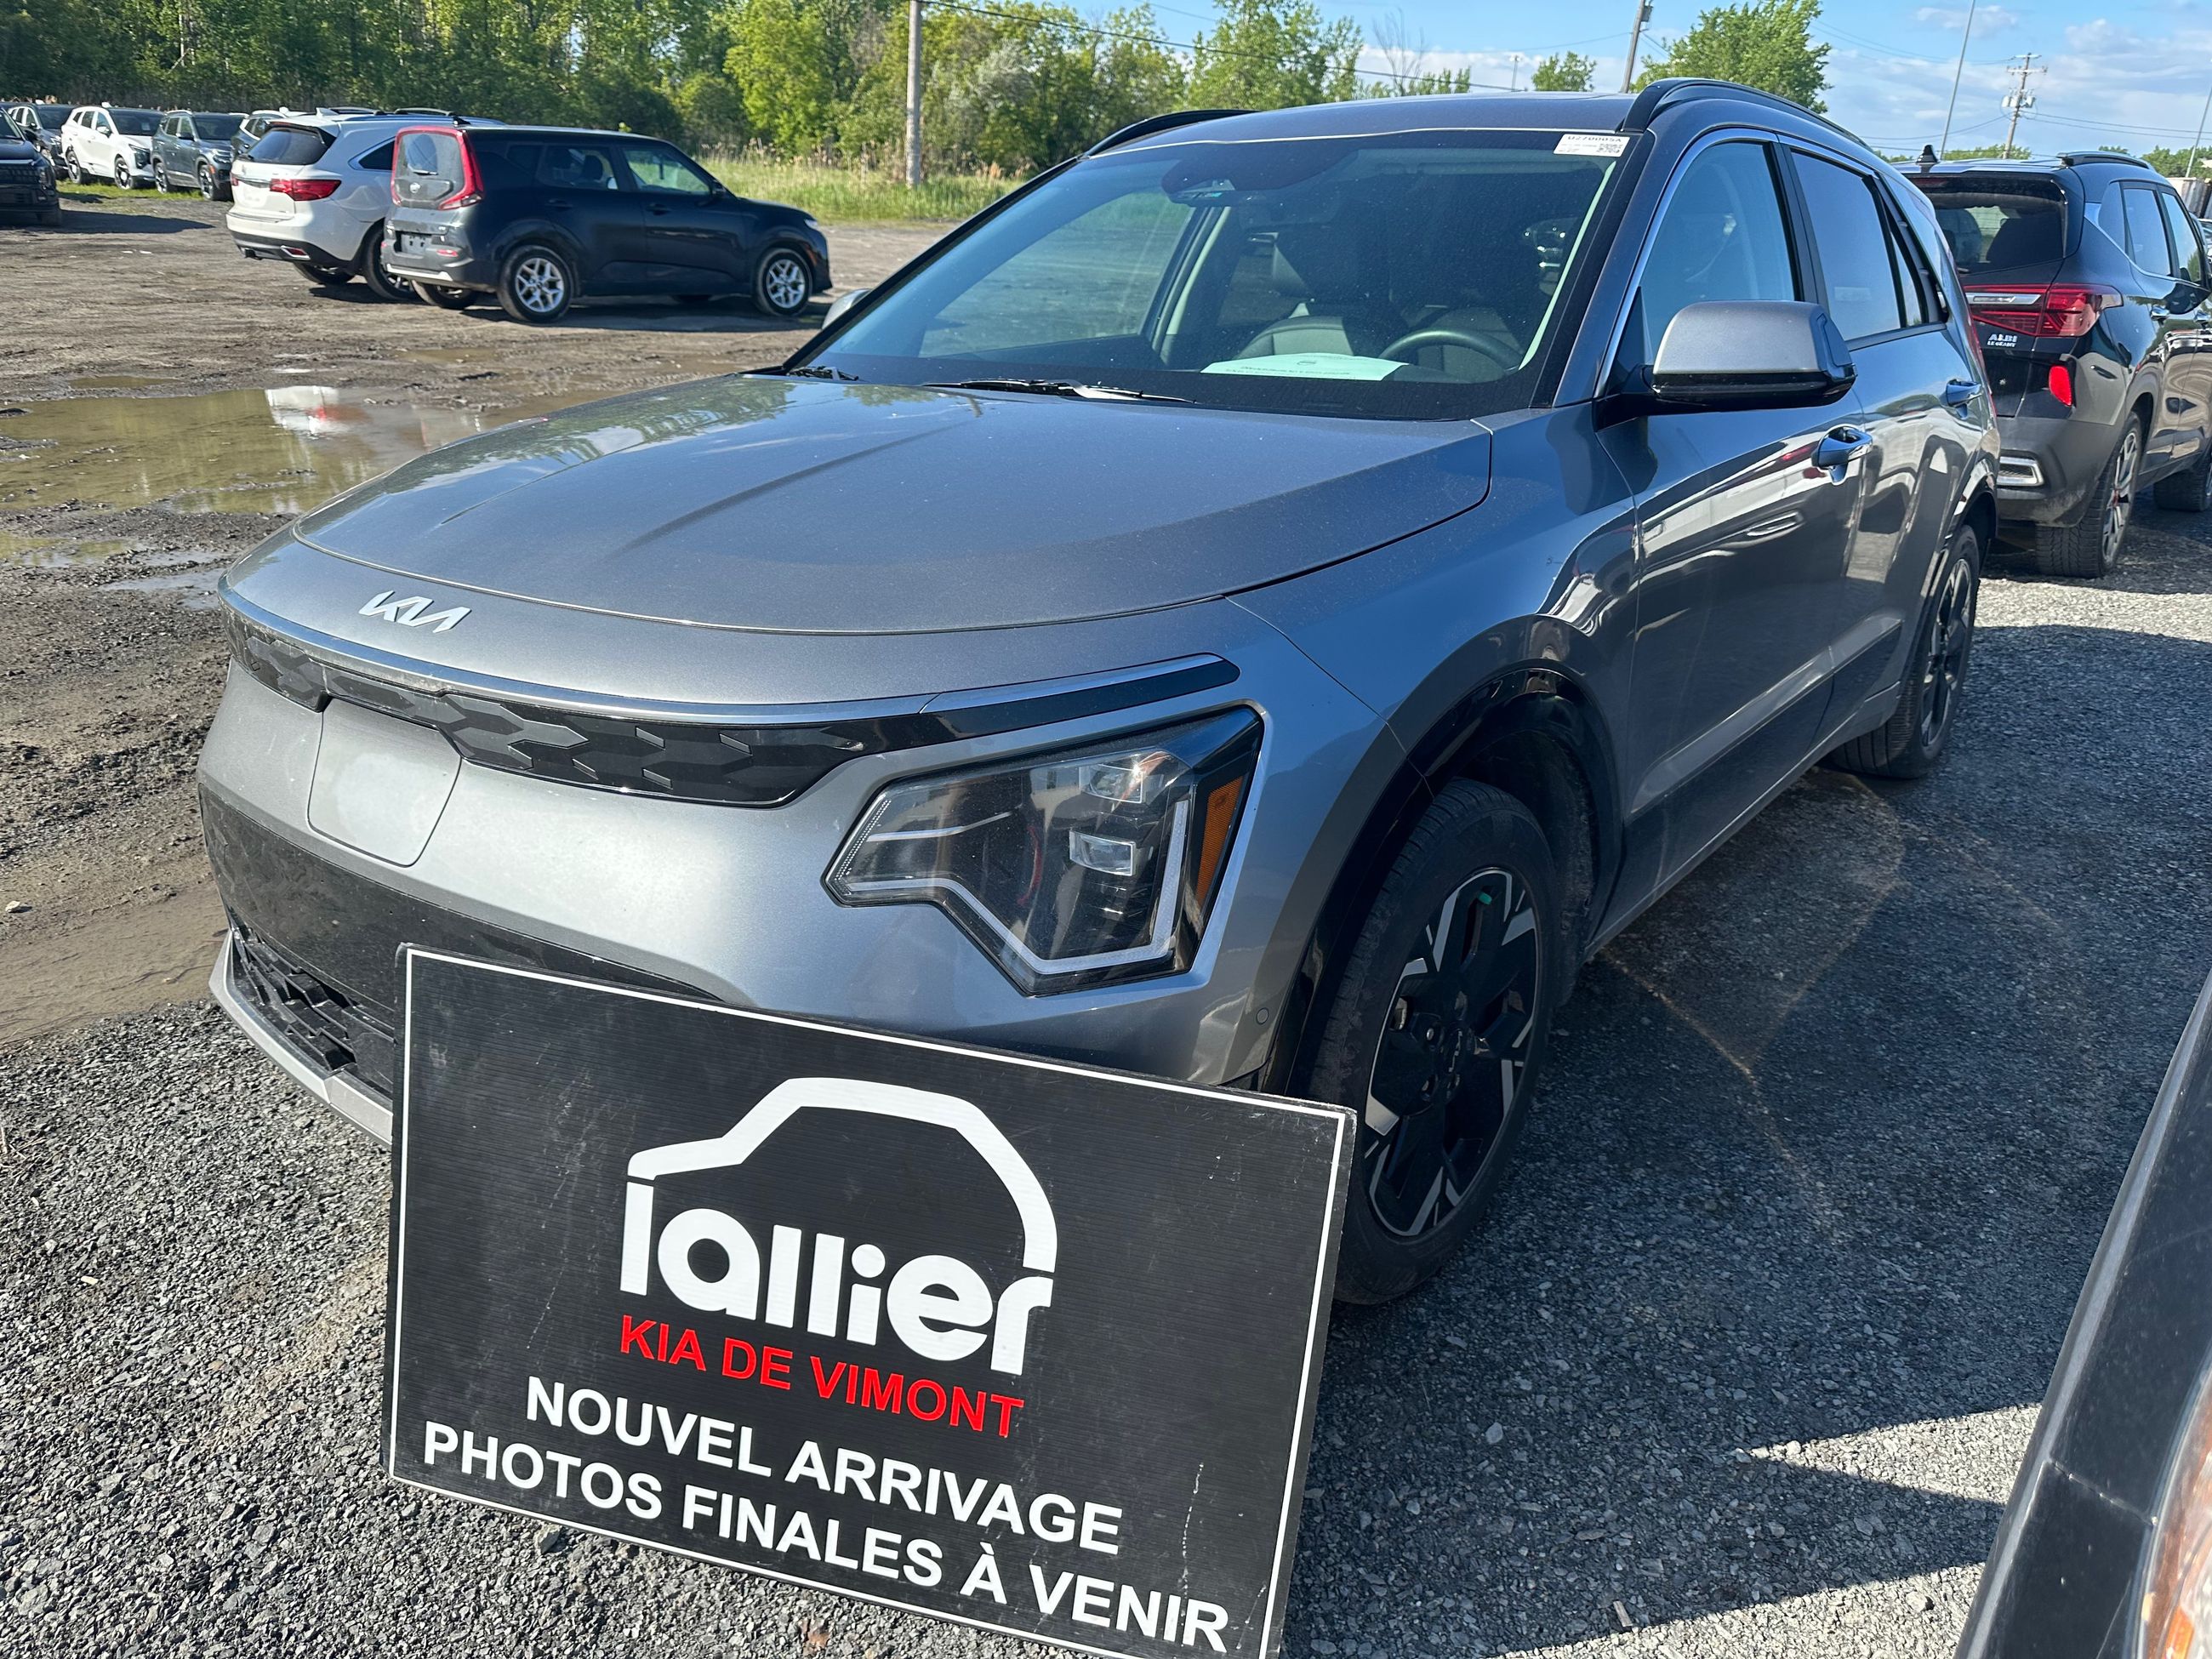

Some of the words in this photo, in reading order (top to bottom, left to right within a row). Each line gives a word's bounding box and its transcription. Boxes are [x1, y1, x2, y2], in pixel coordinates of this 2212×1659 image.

[358, 590, 471, 633] KIA
[620, 1314, 708, 1372] KIA
[721, 1337, 795, 1390] DE
[810, 1355, 1025, 1439] VIMONT
[424, 1420, 663, 1519] PHOTOS
[681, 1484, 944, 1588] FINALES
[959, 1542, 1007, 1605] À
[1028, 1564, 1229, 1655] VENIR
[526, 1376, 772, 1479] NOUVEL
[784, 1440, 1123, 1555] ARRIVAGE
